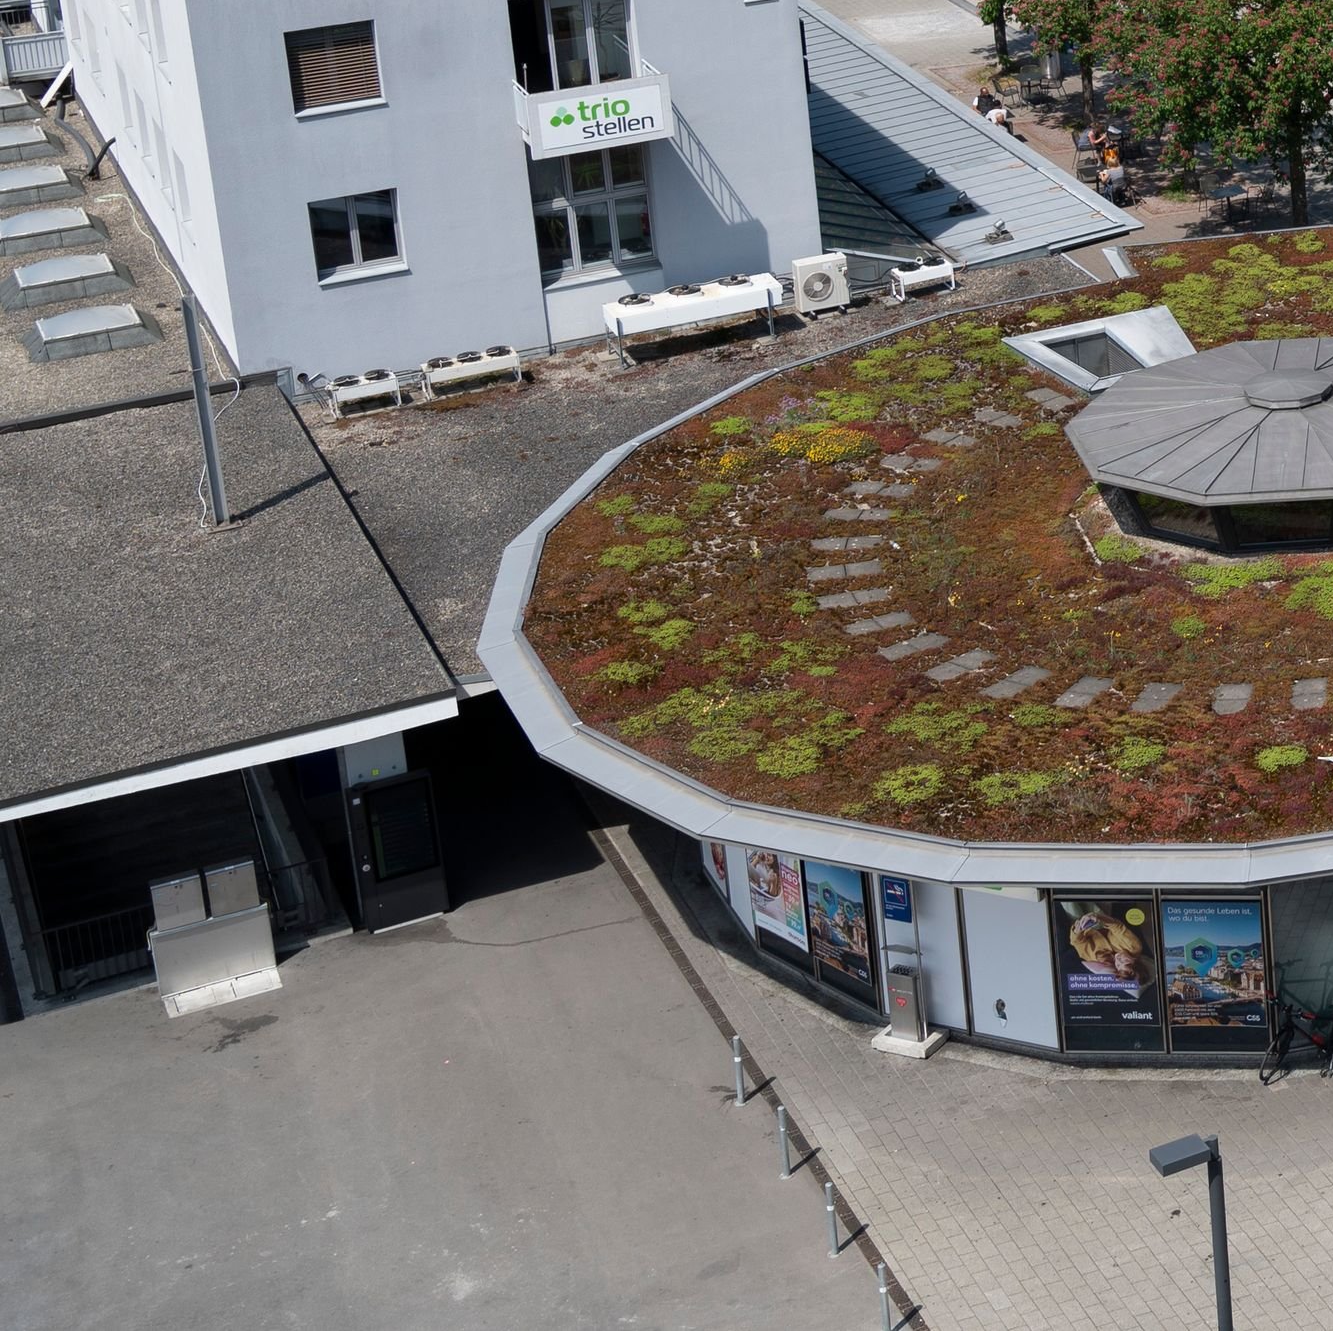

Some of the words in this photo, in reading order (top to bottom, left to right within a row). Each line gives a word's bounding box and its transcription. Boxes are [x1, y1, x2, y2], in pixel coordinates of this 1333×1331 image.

[577, 98, 630, 121] trio
[582, 115, 655, 139] stellen
[1183, 907, 1214, 916] gesunde
[1121, 1011, 1153, 1020] valiant
[1246, 1014, 1261, 1022] CSS
